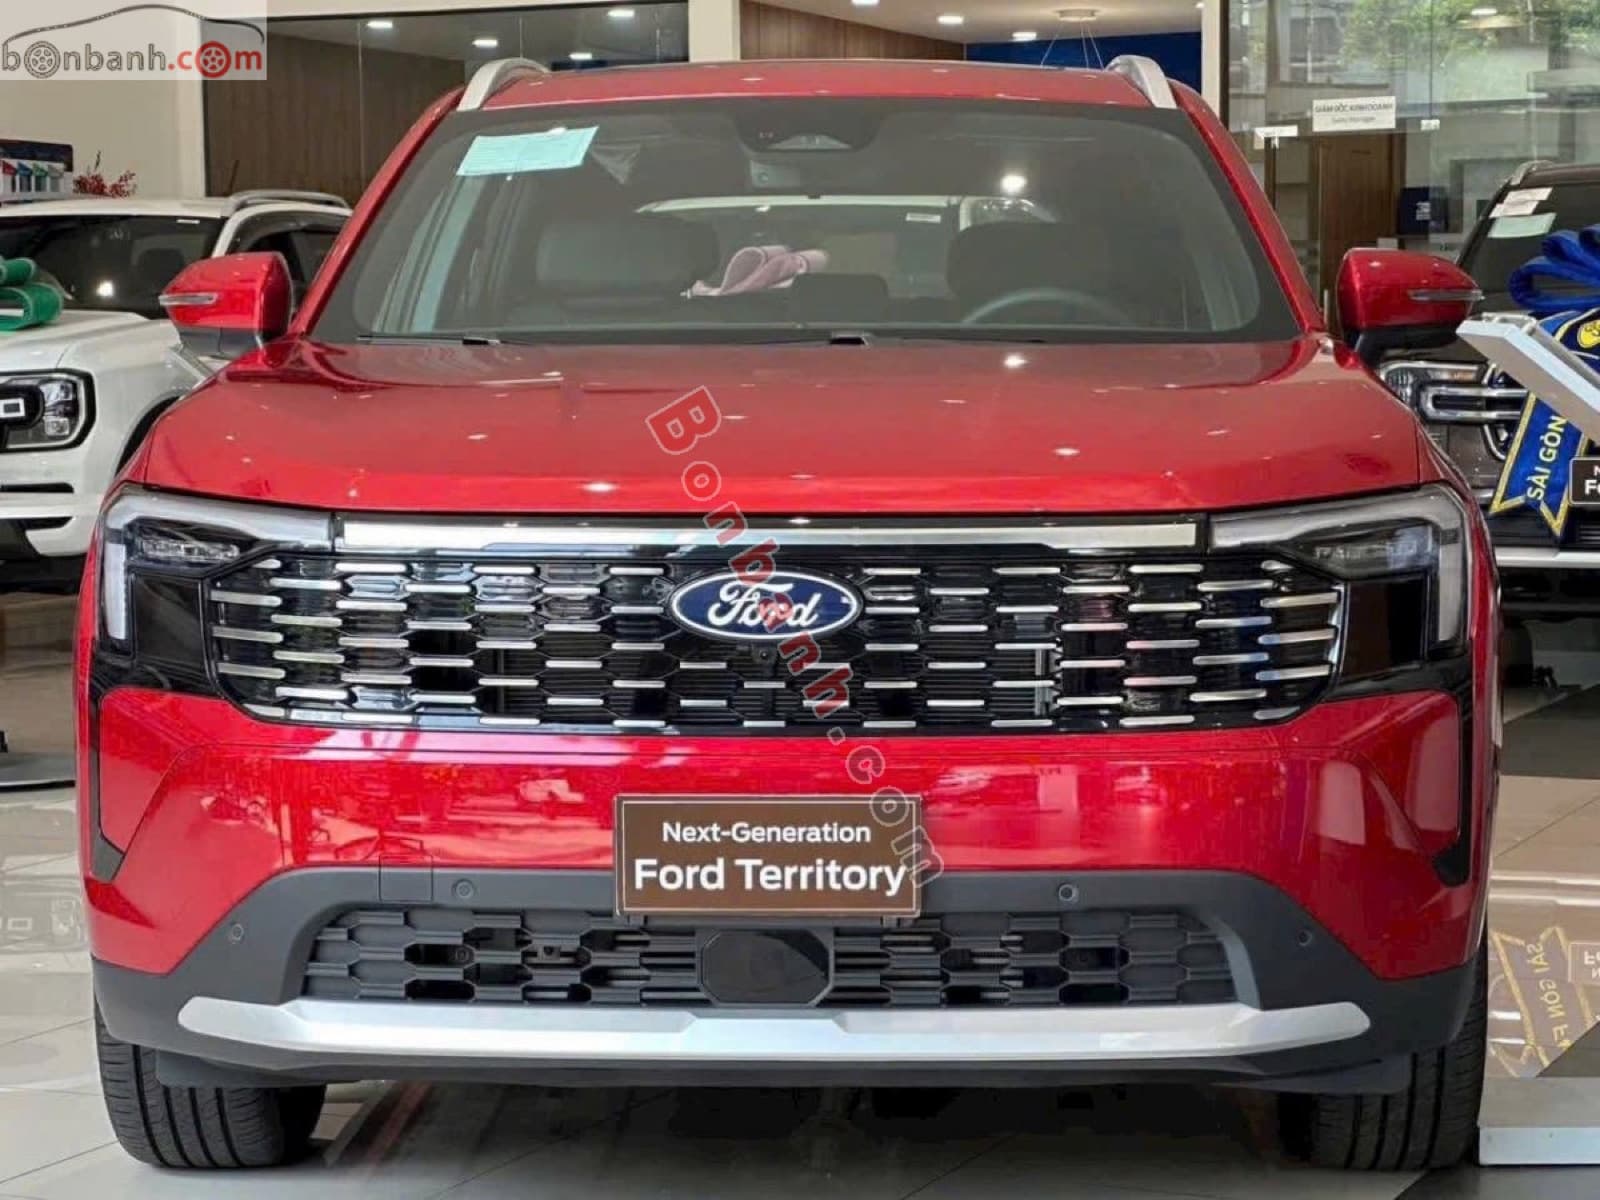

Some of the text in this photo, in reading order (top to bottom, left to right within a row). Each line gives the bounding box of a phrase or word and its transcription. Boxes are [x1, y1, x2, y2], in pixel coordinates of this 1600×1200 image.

[707, 582, 822, 626] Ford
[662, 821, 871, 843] Next-Generation
[634, 858, 907, 896] Ford Territory
